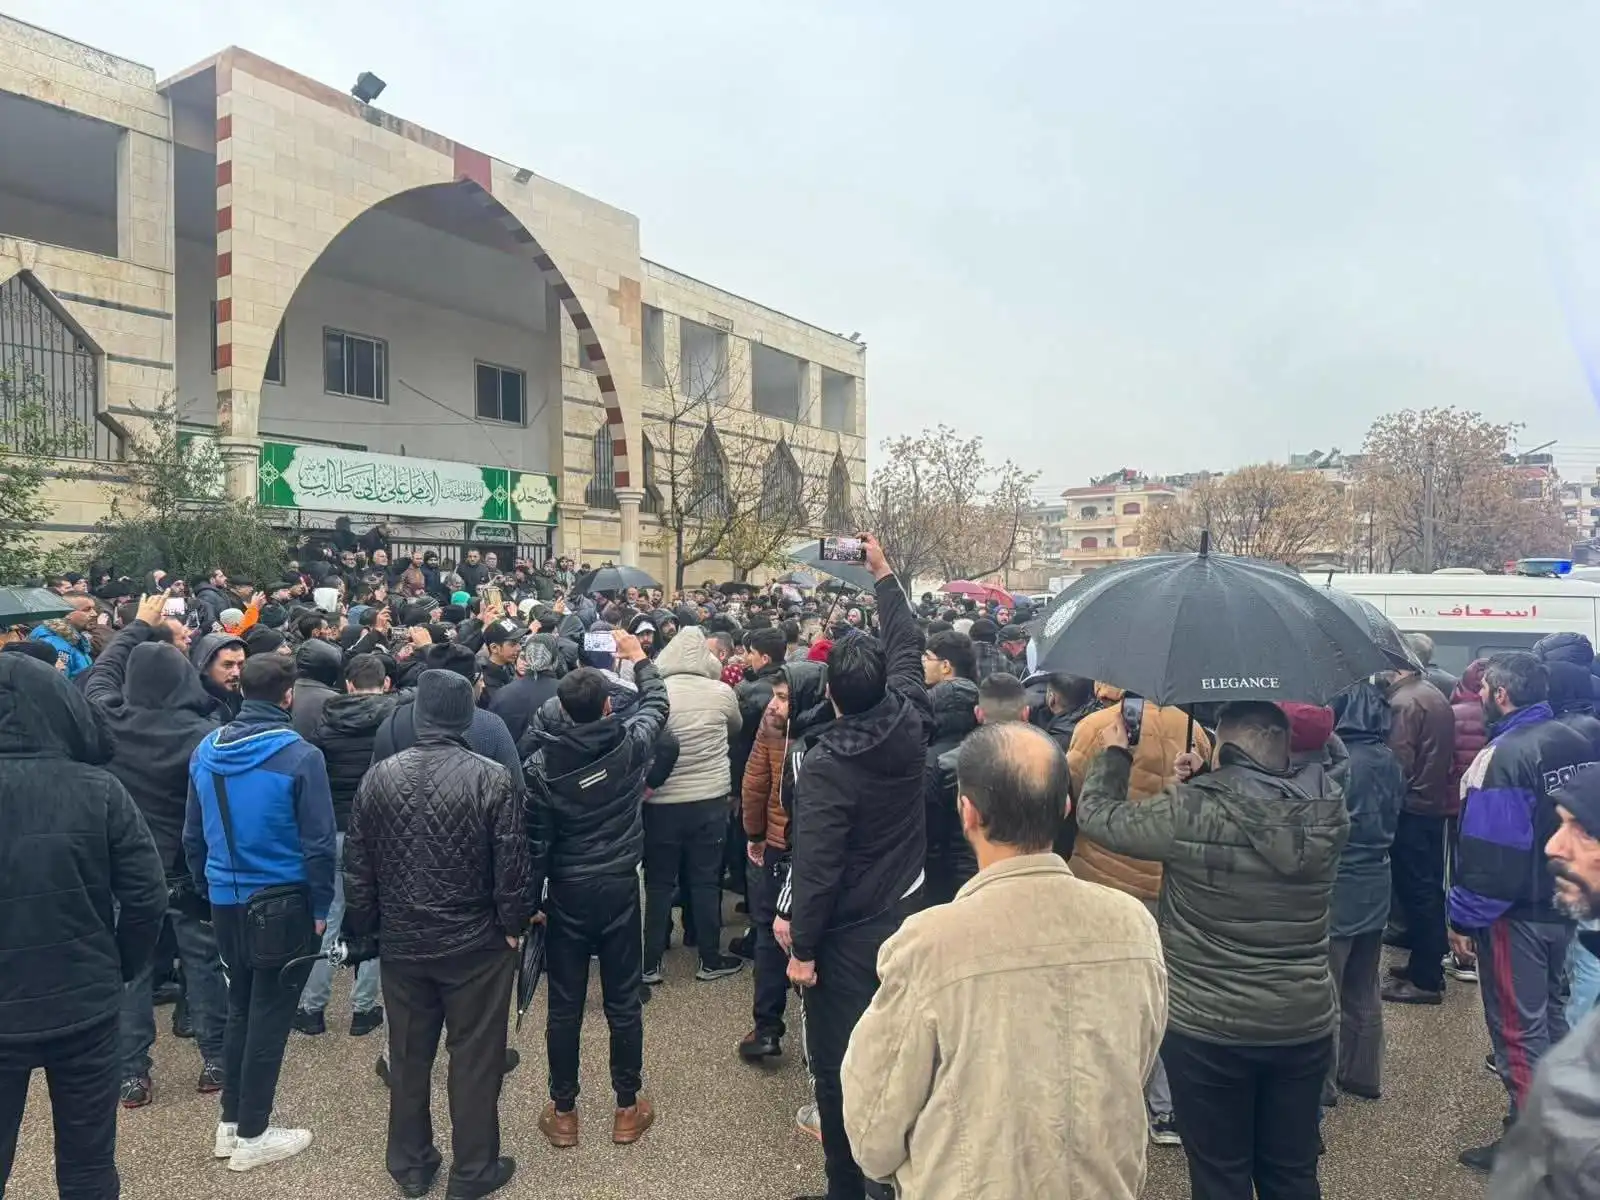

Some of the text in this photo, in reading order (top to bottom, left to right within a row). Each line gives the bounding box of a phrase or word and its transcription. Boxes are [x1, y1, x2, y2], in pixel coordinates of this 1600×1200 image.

[298, 458, 353, 497] طالب
[517, 487, 553, 508] مسجد
[1201, 677, 1280, 690] ELEGANCE
